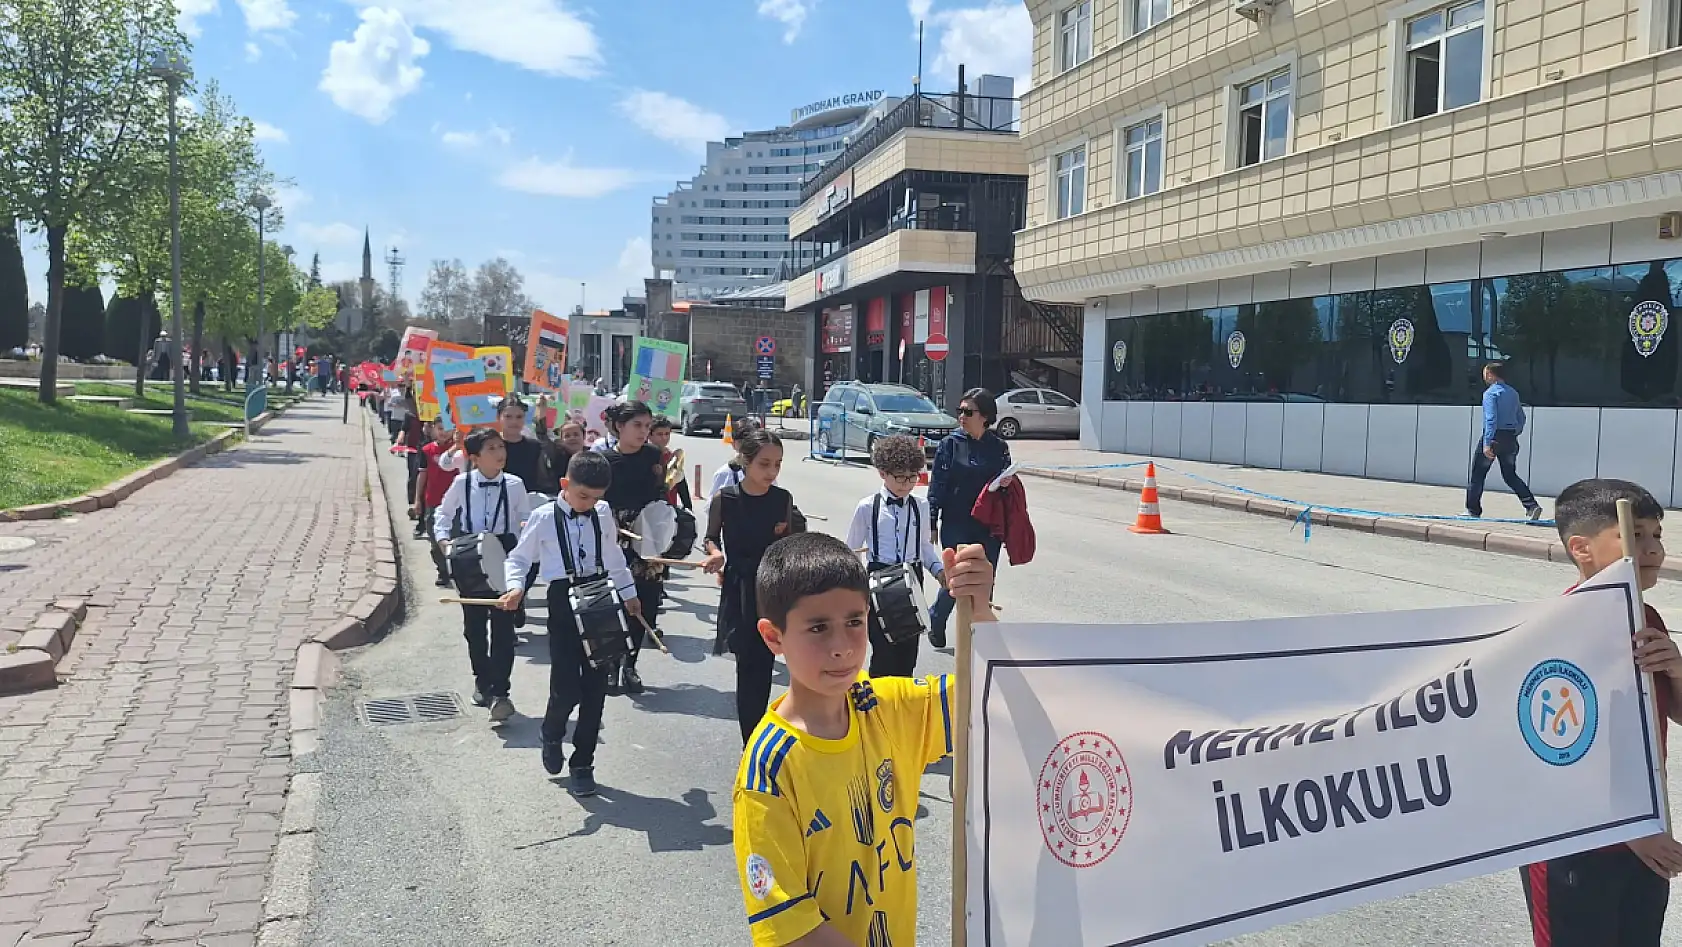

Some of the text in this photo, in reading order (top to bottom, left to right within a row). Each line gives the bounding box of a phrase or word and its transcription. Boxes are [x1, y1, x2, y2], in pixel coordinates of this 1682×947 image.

[799, 90, 882, 117] WYNDHAM GRAND
[1525, 670, 1543, 698] MEHMET
[1164, 703, 1378, 769] MEHMET
[1212, 754, 1452, 853] İLKOKULU
